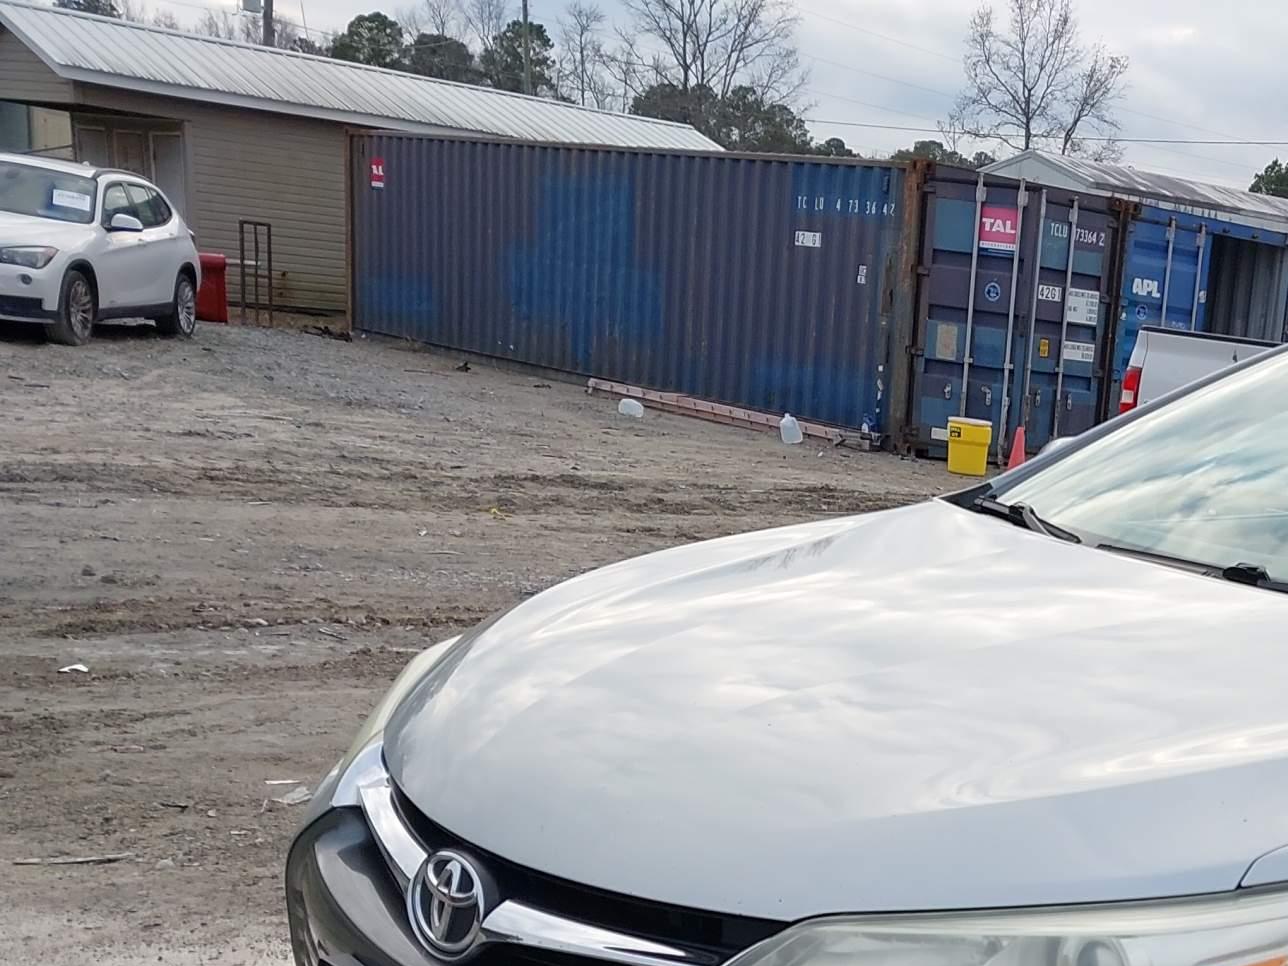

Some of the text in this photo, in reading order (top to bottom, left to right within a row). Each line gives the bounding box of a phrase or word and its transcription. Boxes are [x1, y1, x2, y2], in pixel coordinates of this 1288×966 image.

[982, 218, 1016, 233] TAL
[1050, 222, 1068, 237] TCLU
[1039, 286, 1062, 301] 42G1
[1132, 278, 1160, 298] APL
